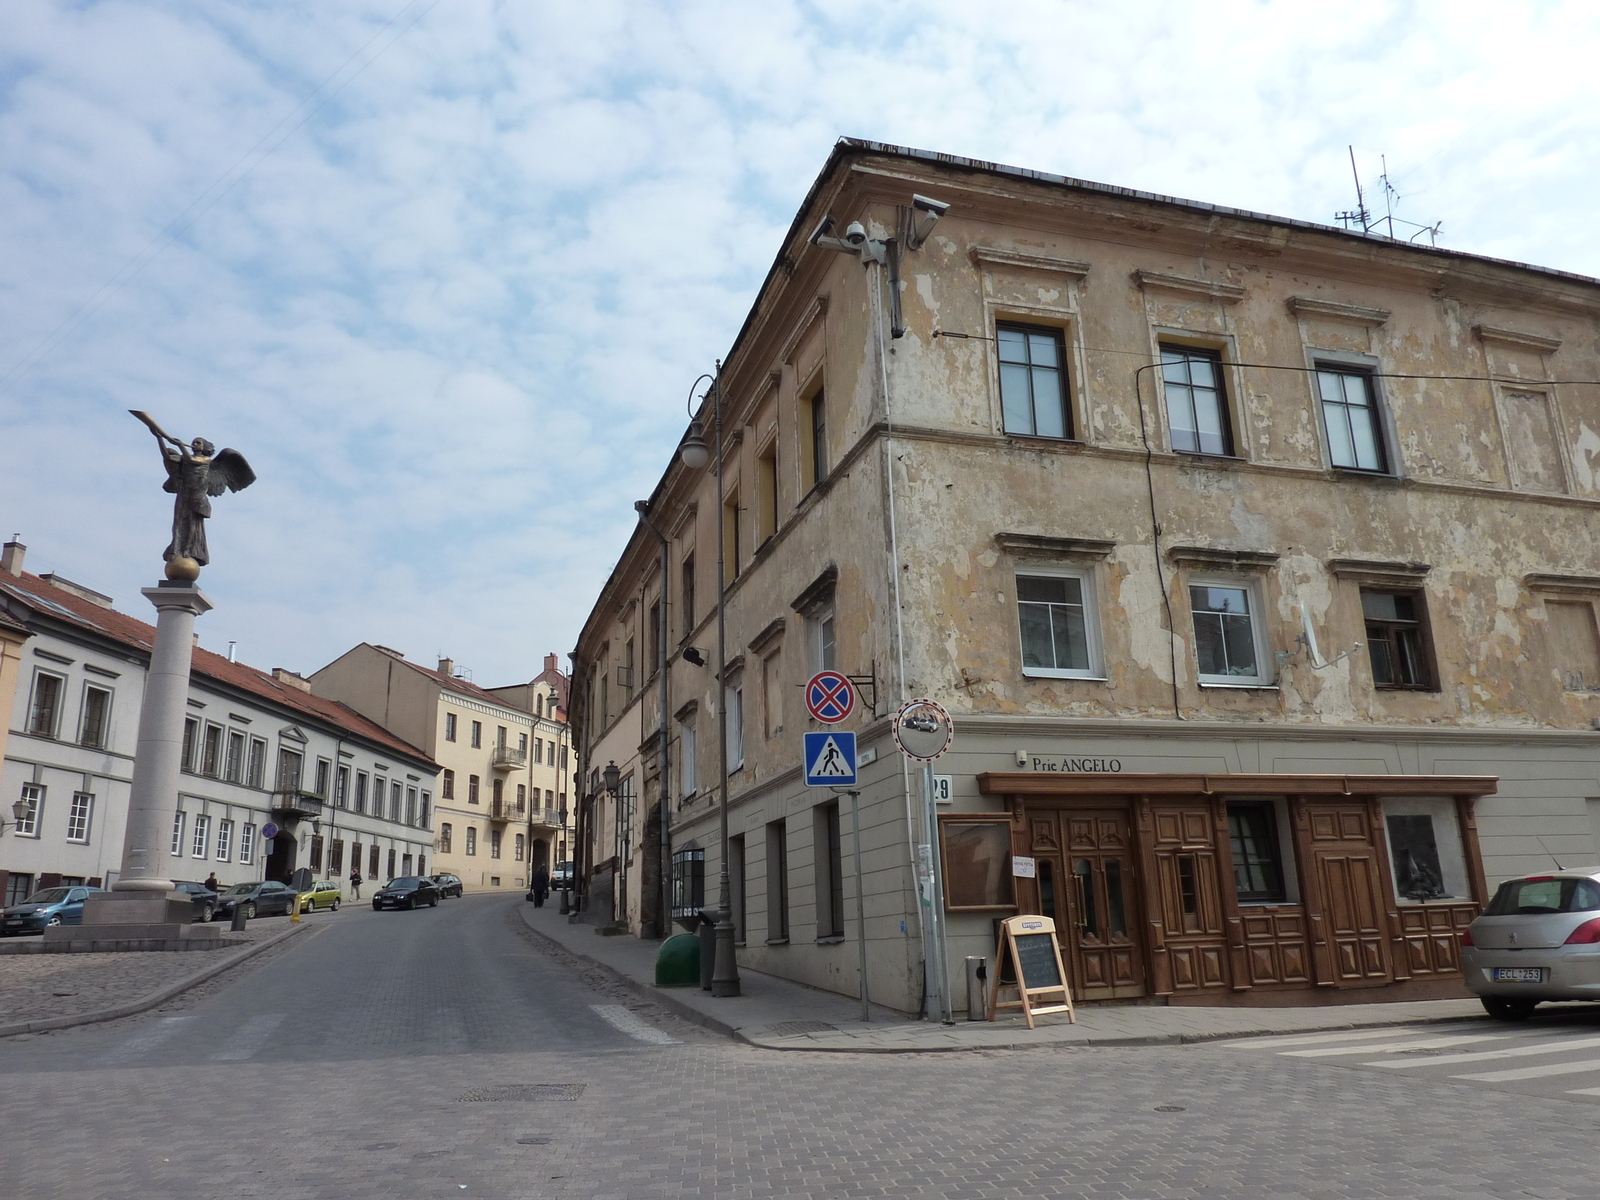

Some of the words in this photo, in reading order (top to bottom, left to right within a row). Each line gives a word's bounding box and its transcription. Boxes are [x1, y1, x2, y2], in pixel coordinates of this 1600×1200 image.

[1032, 758, 1057, 771] Prie
[1061, 758, 1121, 773] ANGELO
[1499, 969, 1517, 979] ECL
[1523, 969, 1539, 979] 253
